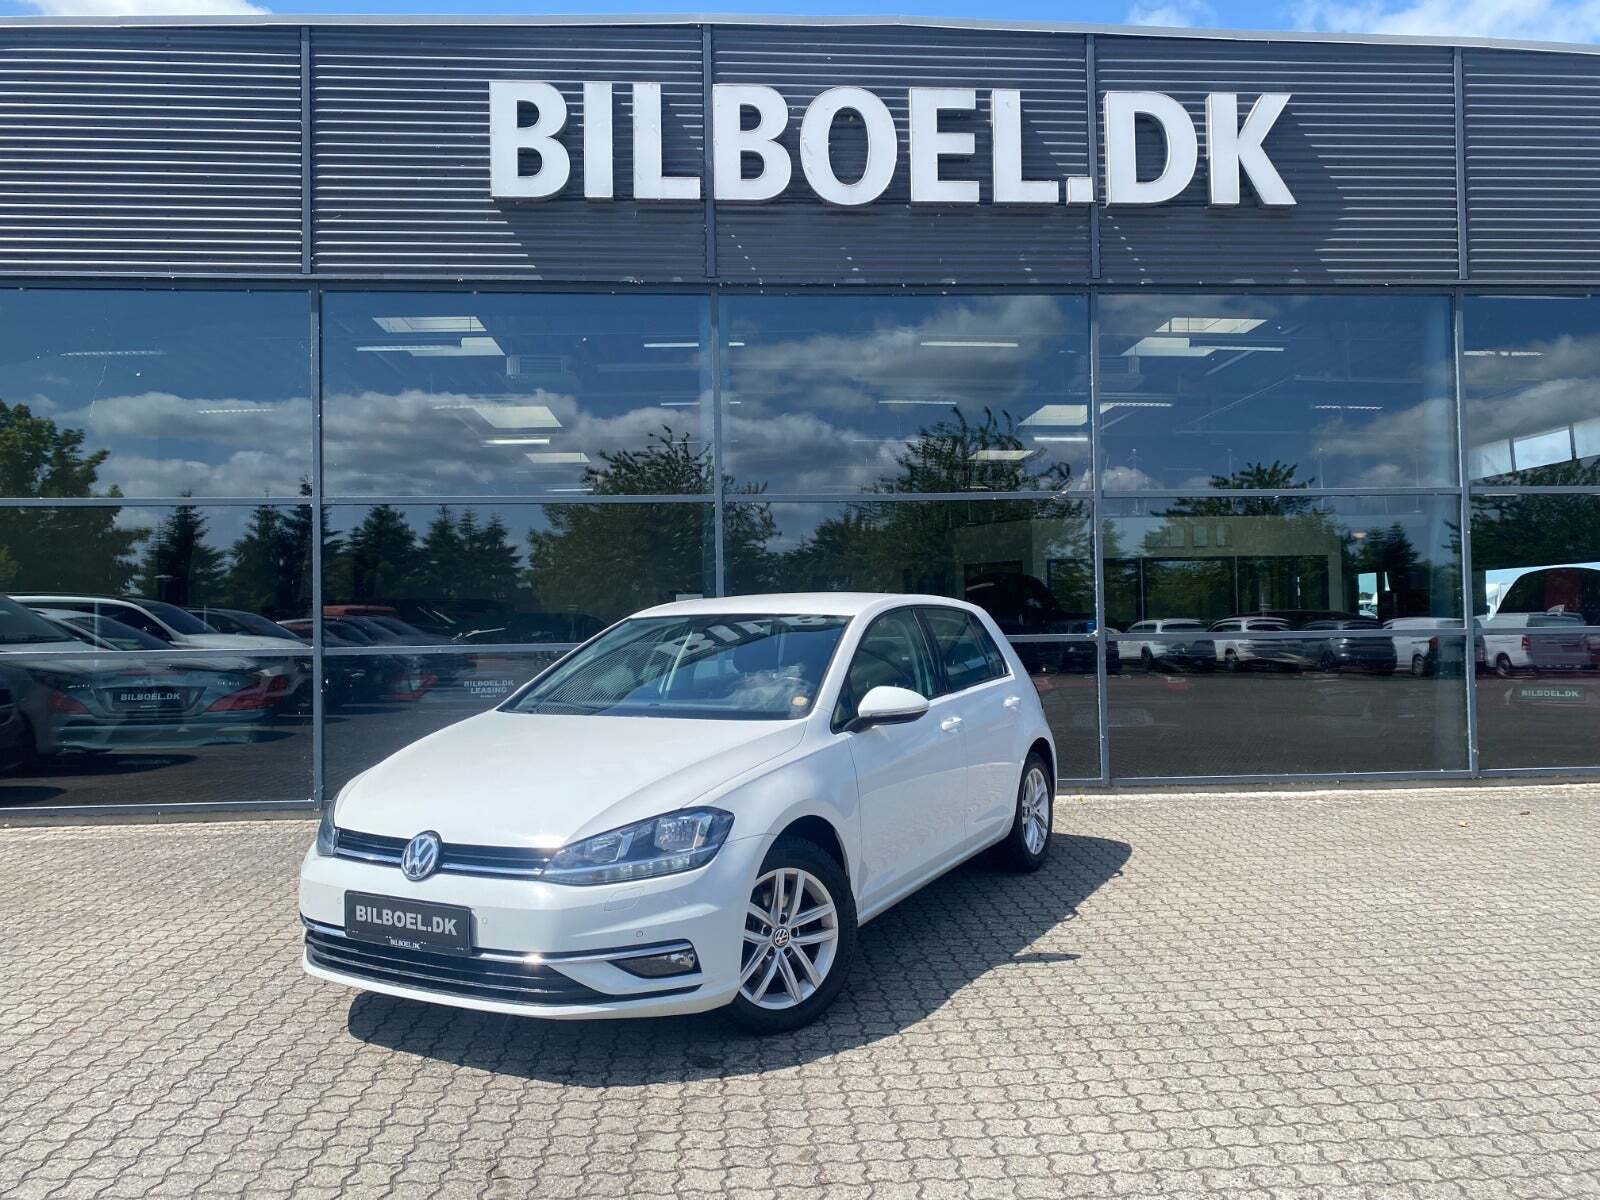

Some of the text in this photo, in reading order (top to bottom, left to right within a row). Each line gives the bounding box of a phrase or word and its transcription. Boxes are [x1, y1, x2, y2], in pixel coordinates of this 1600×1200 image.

[489, 81, 1297, 206] BILBOEL.DK
[120, 692, 181, 702] BILBOEL.DK
[1521, 689, 1579, 697] BILBOEL.DK
[355, 905, 457, 935] BILBOEL.DK
